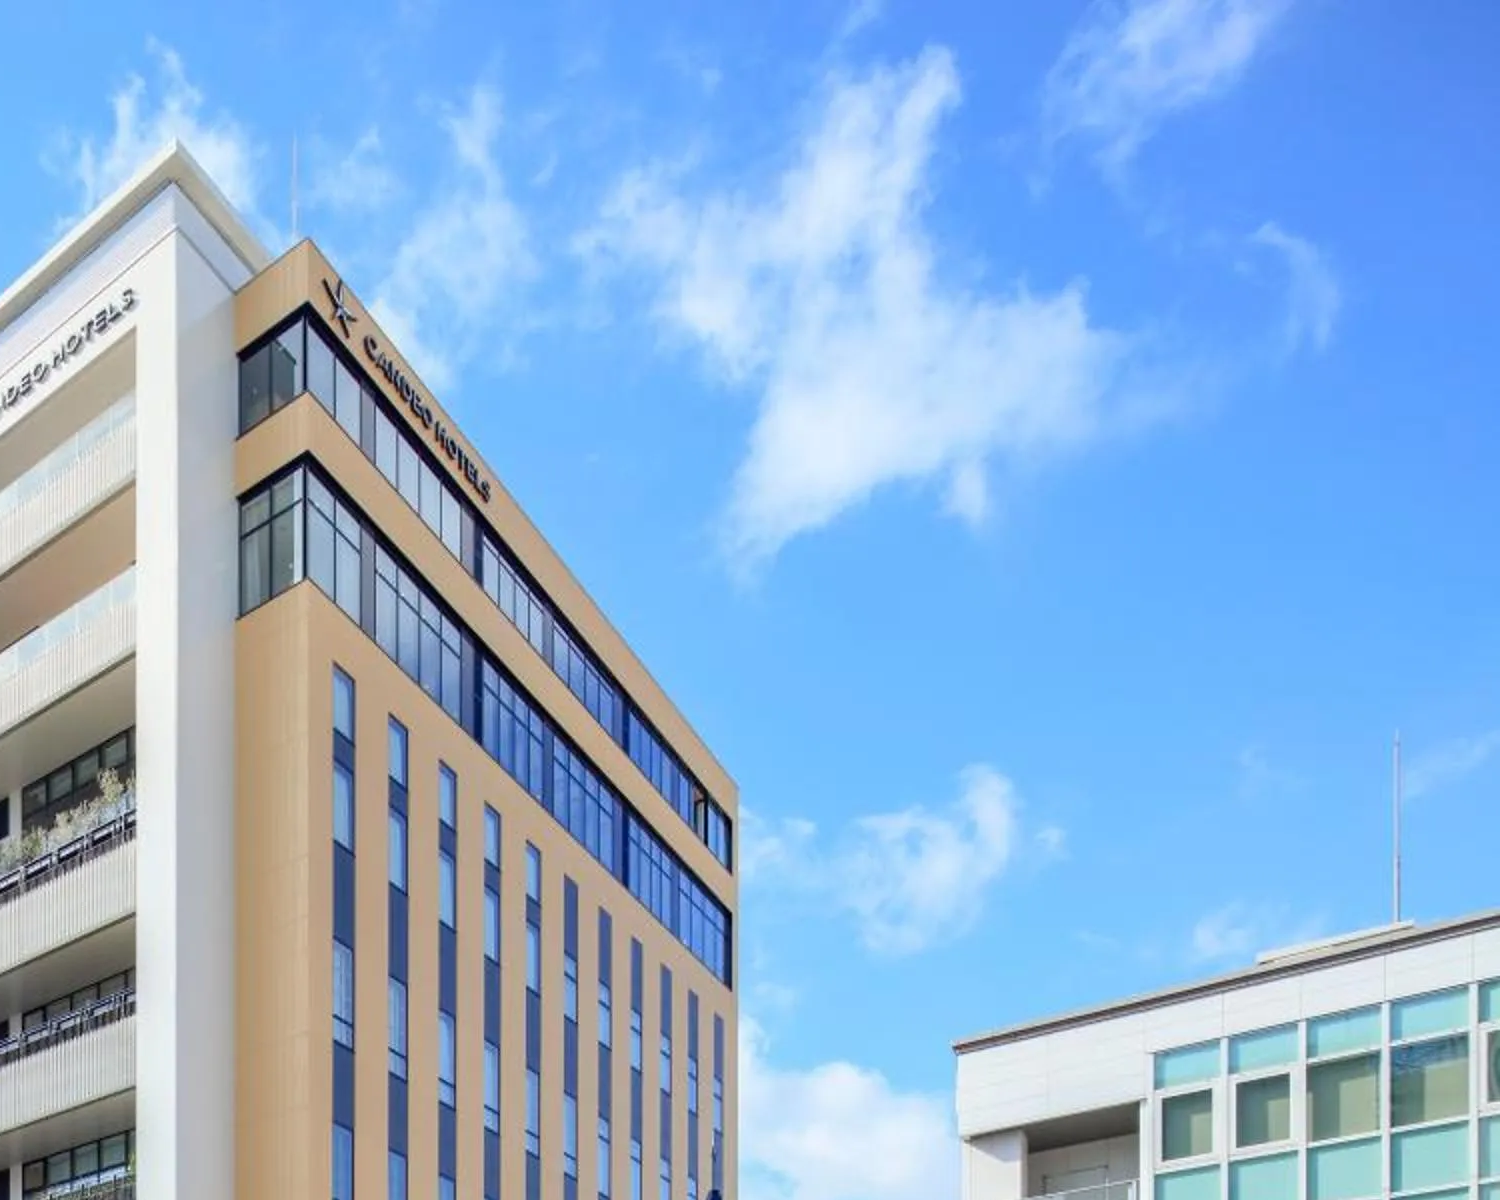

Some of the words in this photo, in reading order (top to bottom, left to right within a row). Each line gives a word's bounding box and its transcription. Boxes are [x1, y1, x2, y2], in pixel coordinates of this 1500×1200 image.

[51, 287, 137, 370] HOTELS
[363, 334, 434, 430] CANDEO
[434, 420, 491, 504] HOTELS
